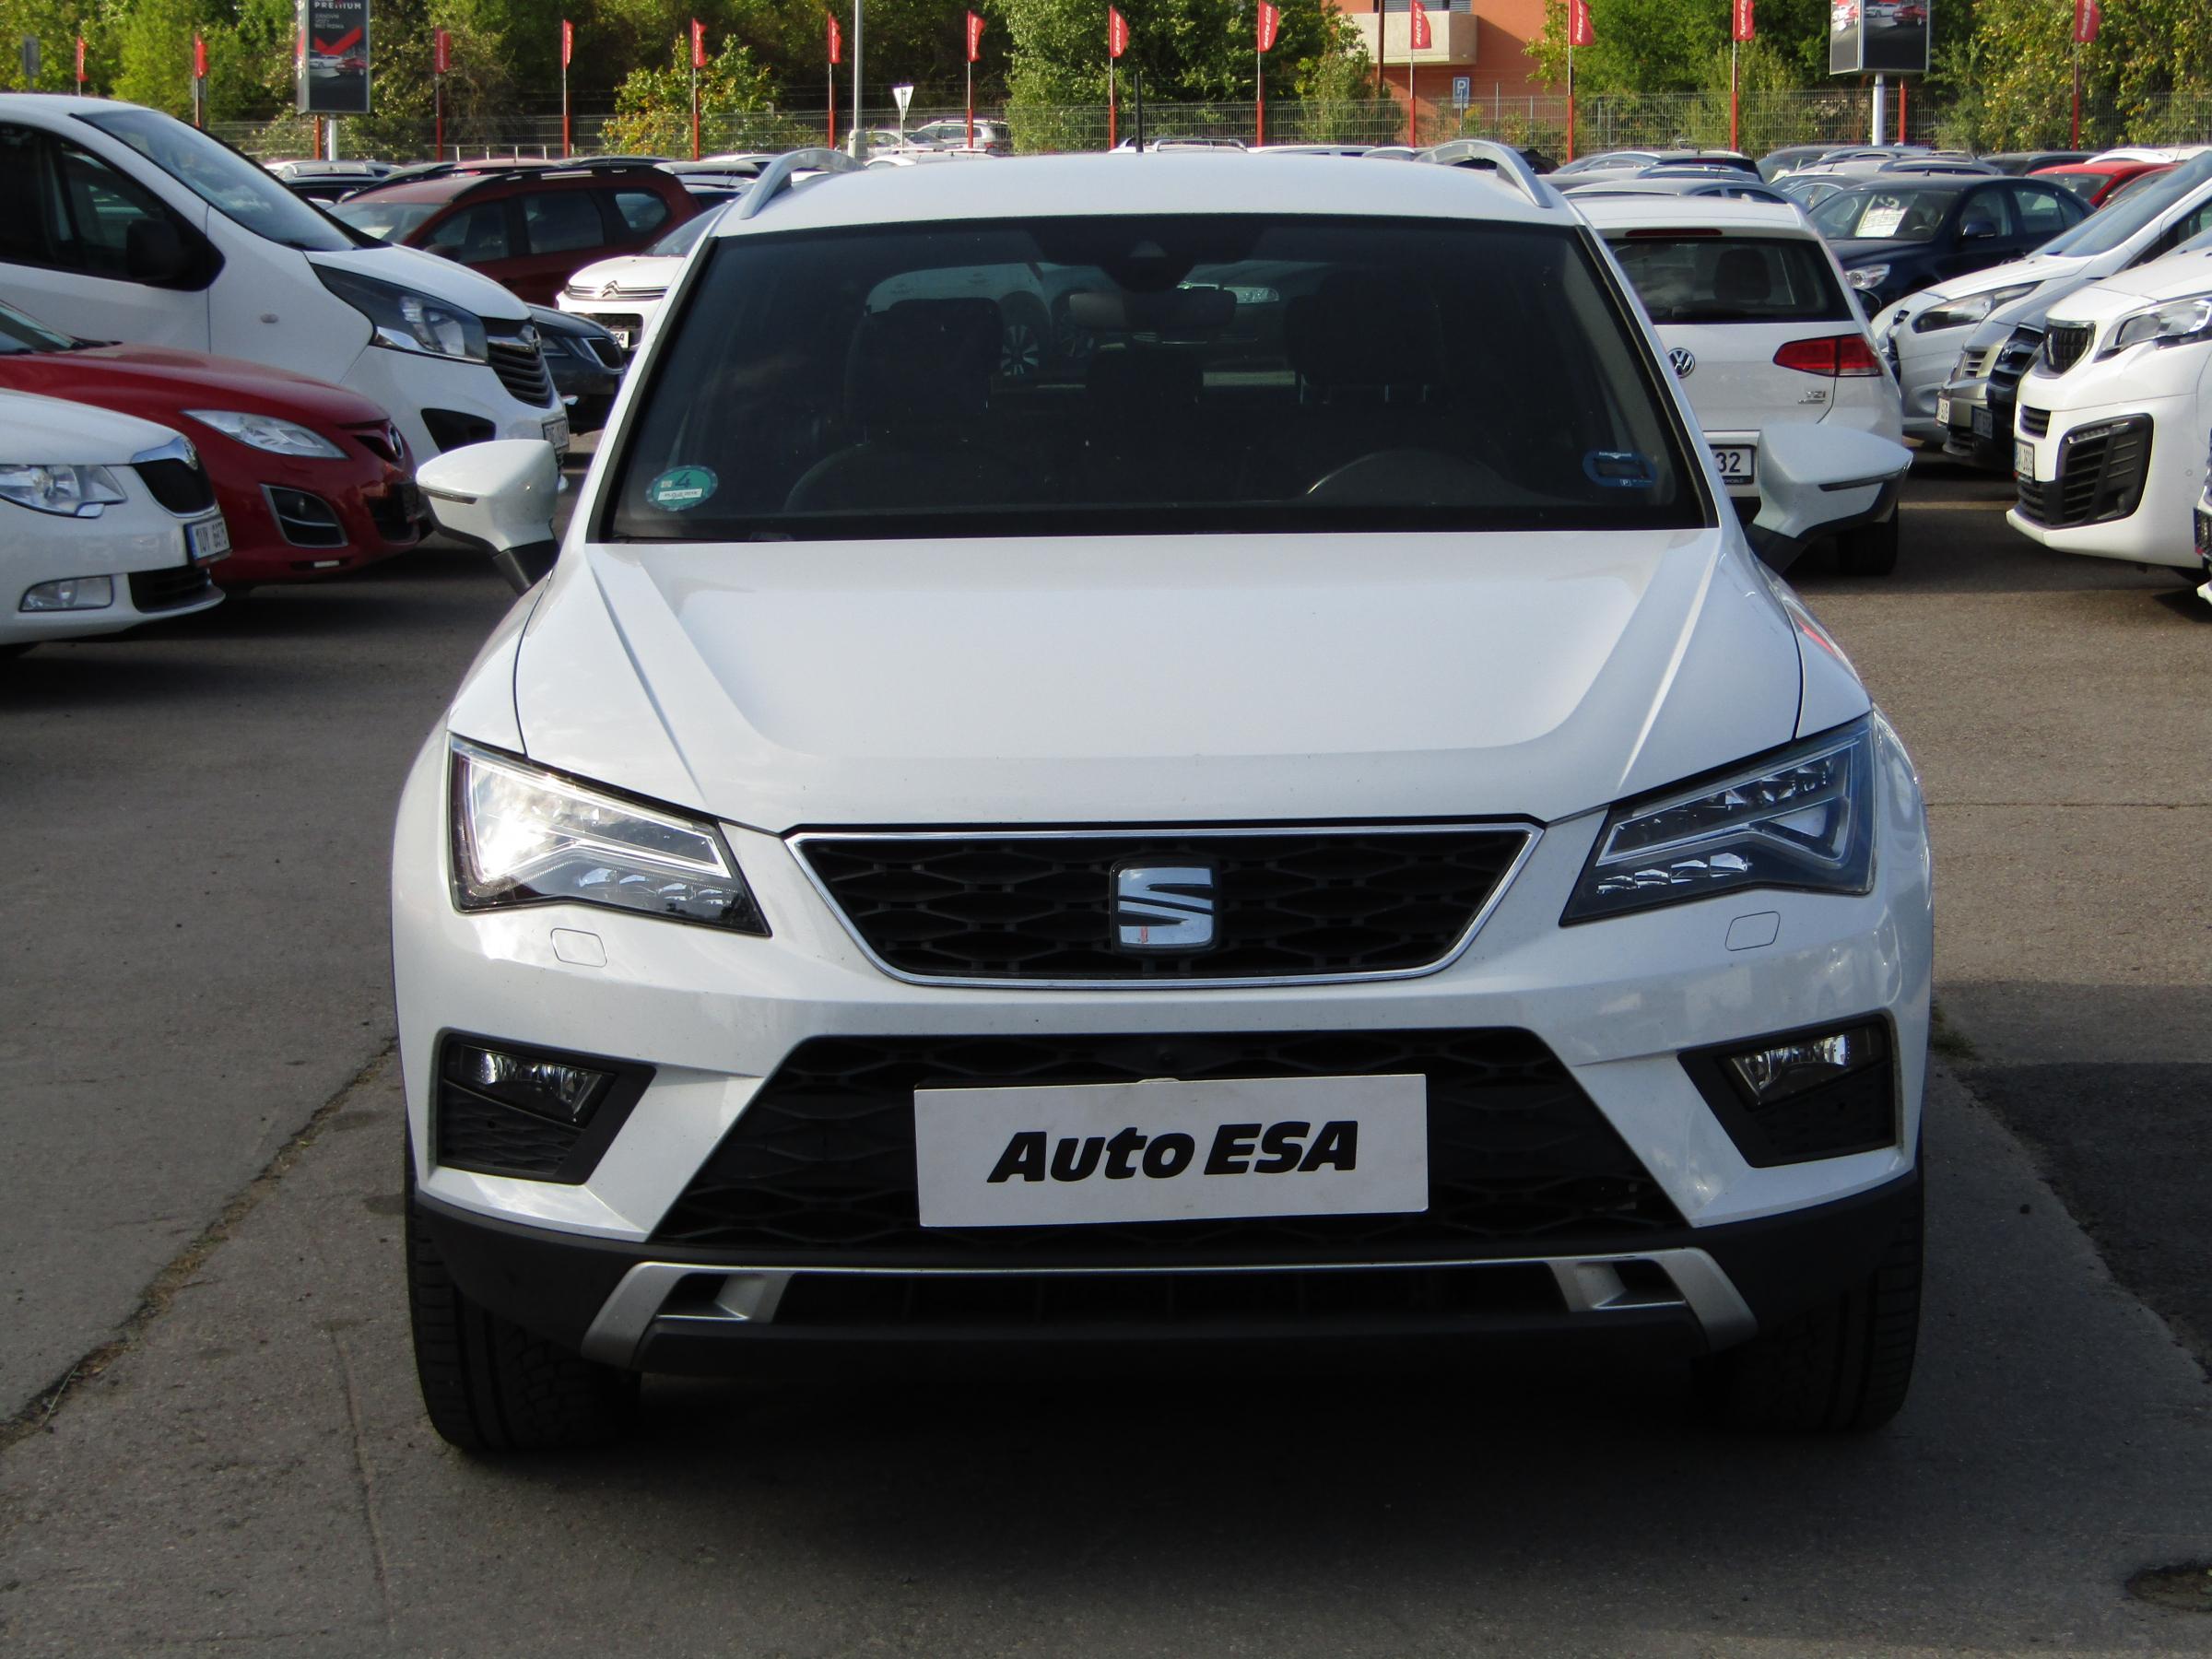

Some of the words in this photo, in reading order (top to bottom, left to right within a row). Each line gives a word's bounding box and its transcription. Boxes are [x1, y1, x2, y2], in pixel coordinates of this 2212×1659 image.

[314, 1, 361, 9] PREMIUM
[1715, 452, 1741, 473] 32
[987, 1127, 1195, 1183] Auto
[1204, 1120, 1359, 1176] ESA
